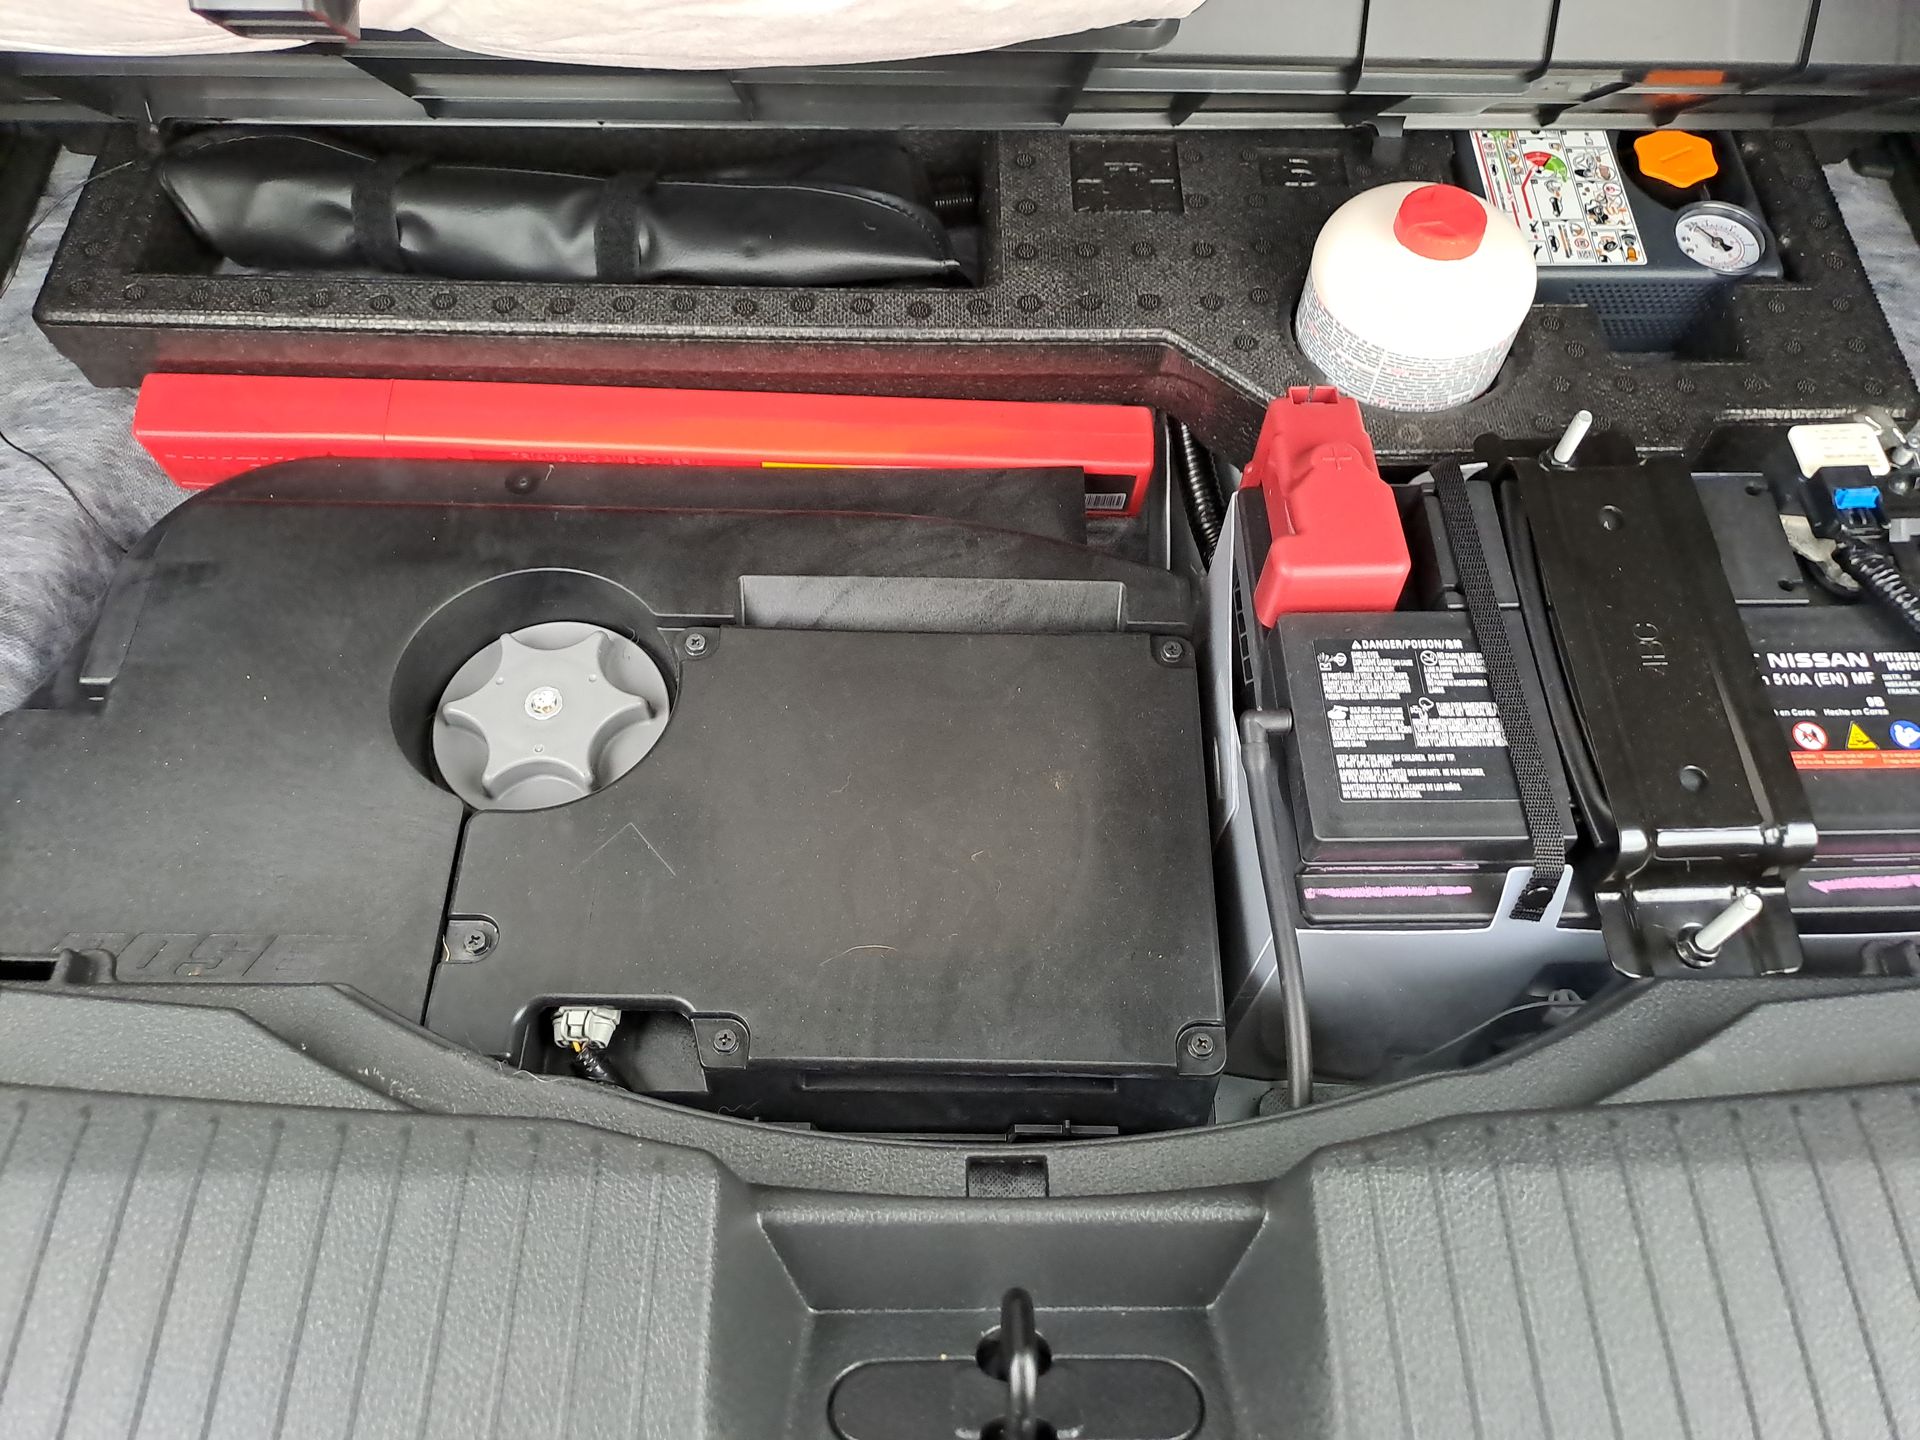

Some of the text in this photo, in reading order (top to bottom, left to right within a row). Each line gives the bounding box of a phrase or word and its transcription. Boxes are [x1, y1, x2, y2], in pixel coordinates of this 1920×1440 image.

[1766, 652, 1870, 668] NISSAN
[1886, 662, 1920, 671] MOTO
[1772, 672, 1813, 686] 510A
[1814, 672, 1848, 688] (EN)
[1851, 672, 1875, 685] MF
